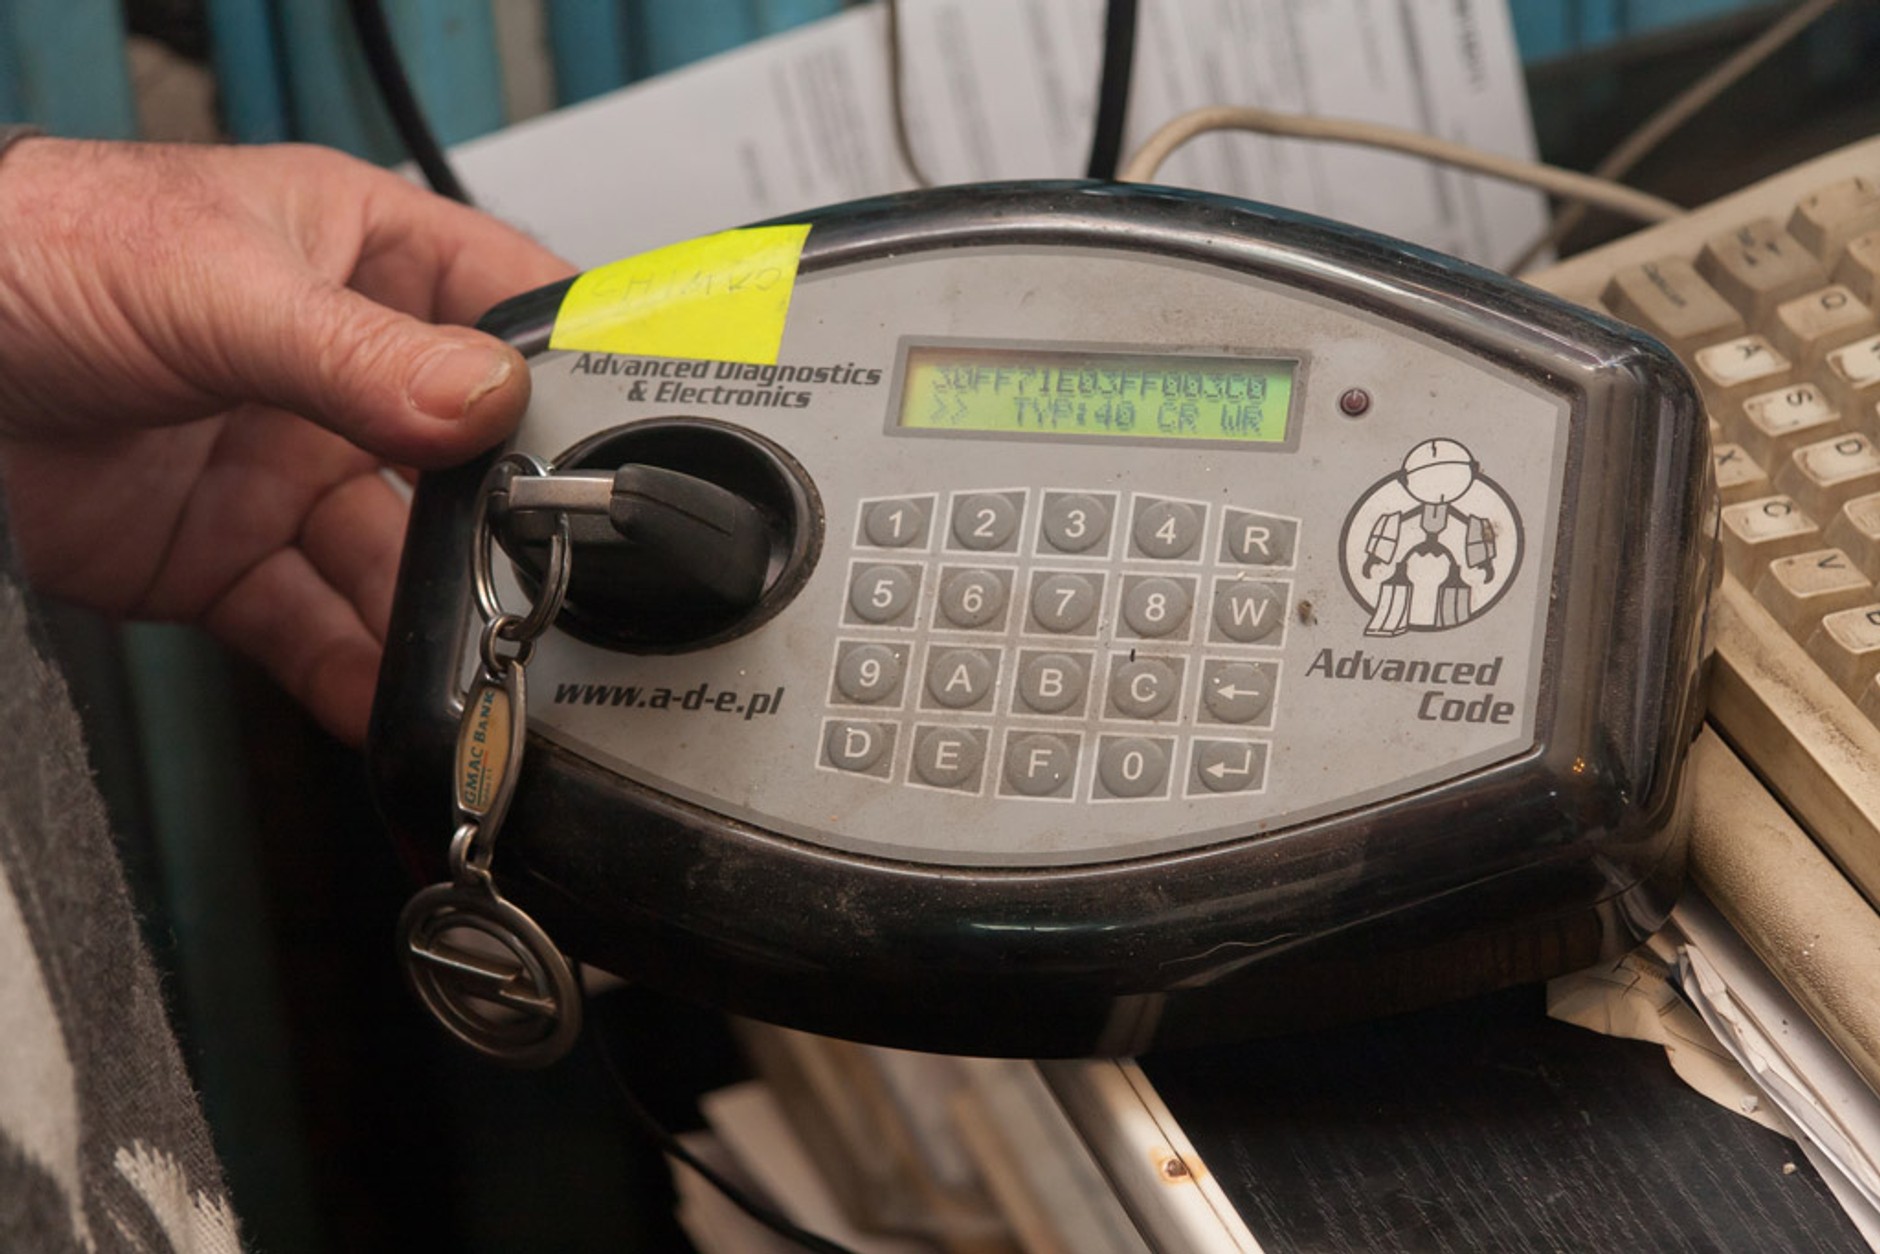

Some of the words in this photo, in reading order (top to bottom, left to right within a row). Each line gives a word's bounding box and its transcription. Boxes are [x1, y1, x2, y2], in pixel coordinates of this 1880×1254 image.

[572, 353, 710, 380] Advanced
[714, 362, 882, 388] Diagnostics
[626, 380, 648, 402] &
[654, 381, 812, 408] Electronics
[1157, 401, 1199, 434] CR
[1219, 404, 1264, 436] WR
[1836, 438, 1863, 456] D
[888, 510, 903, 537] 1
[973, 509, 996, 537] 2
[1065, 510, 1086, 537] 3
[1155, 517, 1177, 545] 4
[1243, 526, 1270, 555] R
[1817, 555, 1846, 569] V
[871, 580, 894, 608] 5
[962, 584, 984, 612] 6
[1055, 589, 1076, 616] 7
[1145, 593, 1165, 621] 8
[1231, 597, 1269, 626] W
[860, 659, 881, 687] 9
[944, 664, 972, 692] A
[1039, 668, 1063, 697] B
[1131, 673, 1158, 702] C
[1305, 648, 1503, 686] Advanced
[553, 683, 785, 720] www.a-d-e.pl
[1417, 690, 1514, 724] Code
[845, 729, 872, 757] D
[935, 741, 961, 770] E
[1028, 749, 1053, 778] F
[1122, 751, 1144, 780] 0
